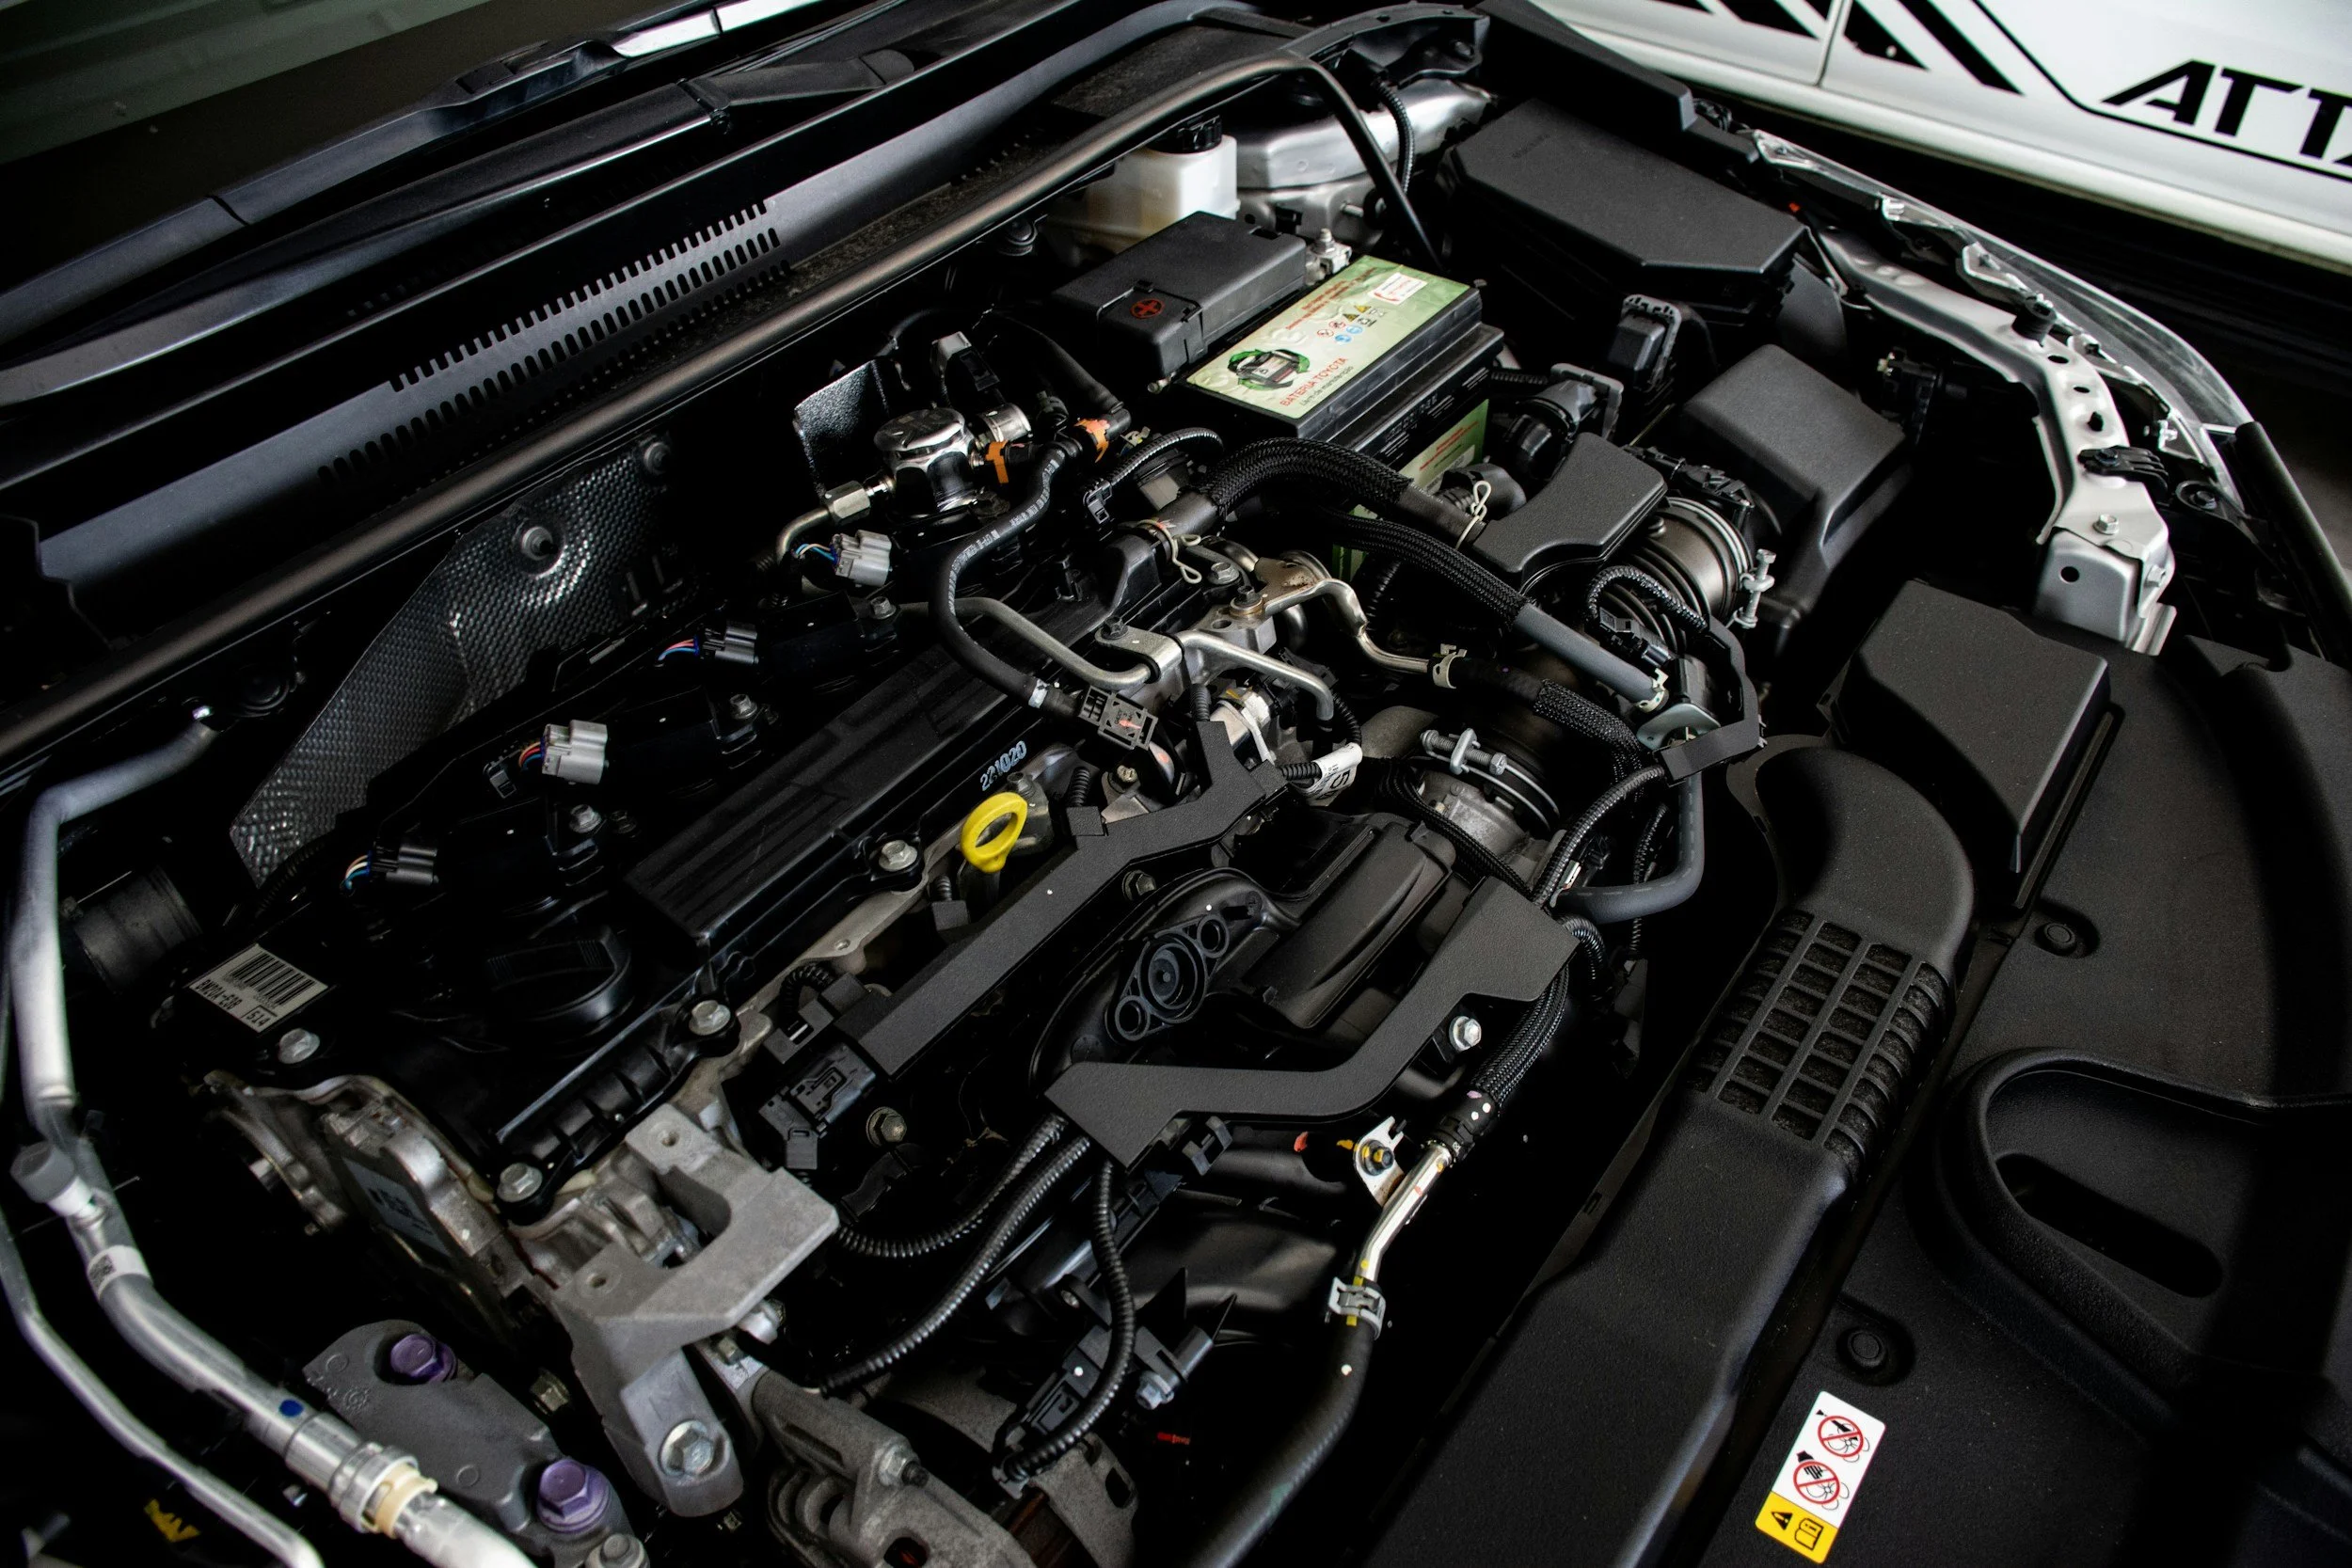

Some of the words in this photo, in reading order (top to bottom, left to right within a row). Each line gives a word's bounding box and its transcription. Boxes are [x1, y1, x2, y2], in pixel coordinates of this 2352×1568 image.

[1279, 380, 1316, 407] BATERIA
[1312, 357, 1348, 380] TOYOTA
[979, 740, 1027, 792] 221020
[246, 1010, 271, 1028] 514
